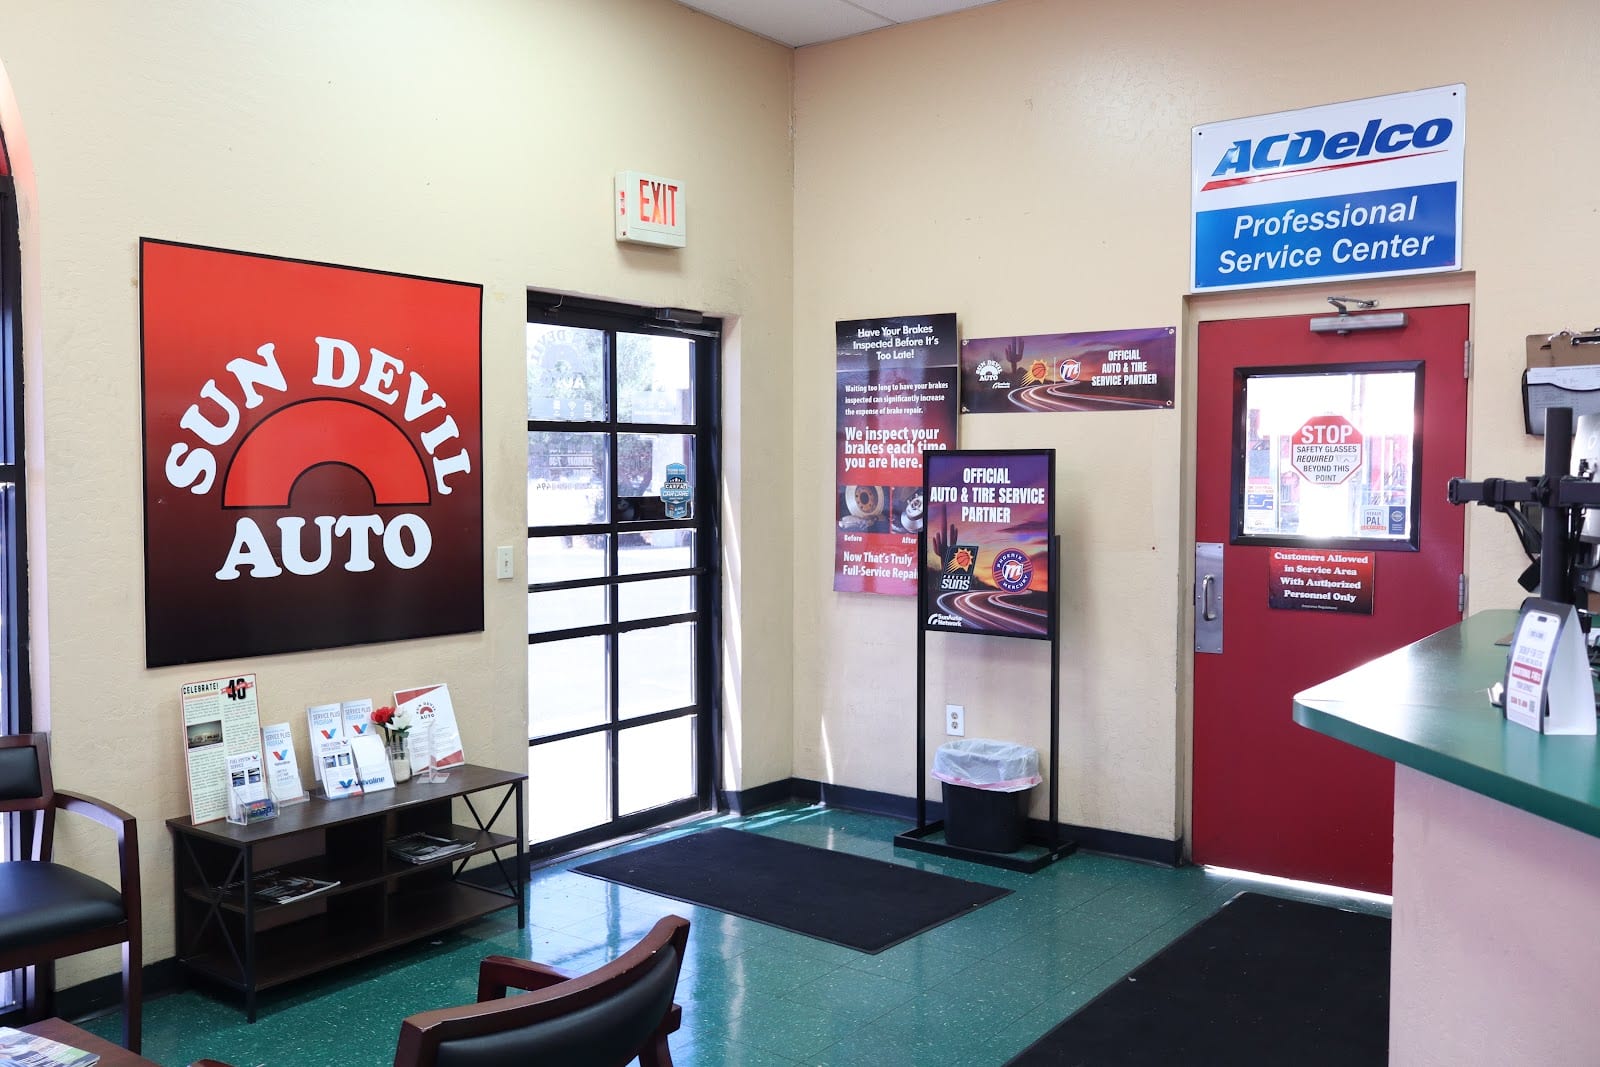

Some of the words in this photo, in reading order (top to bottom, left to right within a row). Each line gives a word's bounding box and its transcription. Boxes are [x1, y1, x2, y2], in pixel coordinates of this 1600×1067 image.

[1211, 118, 1453, 176] ACDelco
[639, 179, 678, 226] EXIT
[1233, 196, 1418, 240] Professional
[1218, 246, 1321, 274] Service
[1332, 234, 1435, 264] Center
[857, 329, 880, 338] Have
[881, 326, 901, 336] Your
[902, 324, 933, 334] Brakes
[853, 339, 893, 351] Inspected
[895, 338, 923, 347] Before
[925, 335, 939, 346] It's
[876, 351, 891, 360] Too
[893, 349, 914, 359] Late!
[1108, 349, 1141, 361] OFFICIAL
[1101, 363, 1121, 373] AUTO
[1123, 362, 1129, 373] &
[1131, 361, 1147, 372] TIRE
[845, 384, 867, 393] Waiting
[878, 384, 892, 392] long
[914, 383, 928, 391] your
[928, 381, 948, 389] brakes
[1091, 375, 1122, 386] SERVICE
[1123, 374, 1157, 386] PARTNER
[845, 396, 872, 405] inspected
[884, 395, 920, 404] significantly
[165, 343, 287, 494] SUN
[312, 336, 471, 495] DEVIL
[903, 406, 924, 415] repair.
[845, 427, 863, 440] We
[865, 426, 909, 444] inspect
[911, 428, 940, 444] your
[1301, 424, 1353, 444] STOP
[845, 440, 884, 454] brakes
[886, 440, 914, 454] each
[917, 439, 946, 452] time
[1296, 445, 1323, 453] SAFETY
[1324, 445, 1357, 453] GLASSES
[845, 457, 865, 472] you
[868, 457, 887, 468] are
[890, 454, 922, 468] here.
[1296, 454, 1334, 463] REQUIRED
[1303, 464, 1332, 472] BEYOND
[1333, 464, 1350, 472] THIS
[963, 467, 1011, 484] OFFICIAL
[1315, 474, 1337, 482] POINT
[930, 486, 958, 502] AUTO
[961, 487, 969, 503] &
[972, 487, 996, 503] TIRE
[998, 487, 1045, 504] SERVICE
[961, 506, 1011, 523] PARTNER
[844, 534, 862, 542] Before
[901, 536, 917, 544] After
[215, 513, 432, 580] AUTO
[843, 551, 862, 562] Now
[863, 551, 890, 563] That's
[890, 553, 913, 567] Truly
[996, 553, 1022, 568] PHOENIX
[1274, 552, 1325, 562] Customers
[1327, 554, 1368, 564] Allowed
[842, 564, 891, 578] Full-Service
[1284, 565, 1294, 573] in
[1296, 565, 1332, 574] Service
[1333, 566, 1357, 576] Area
[1003, 574, 1028, 590] MERCURY
[1280, 577, 1304, 586] With
[1306, 579, 1361, 589] Authorized
[1284, 590, 1331, 600] Personnel
[1333, 592, 1357, 602] Only
[183, 682, 219, 695] CELEBRATE!
[227, 678, 246, 701] 40
